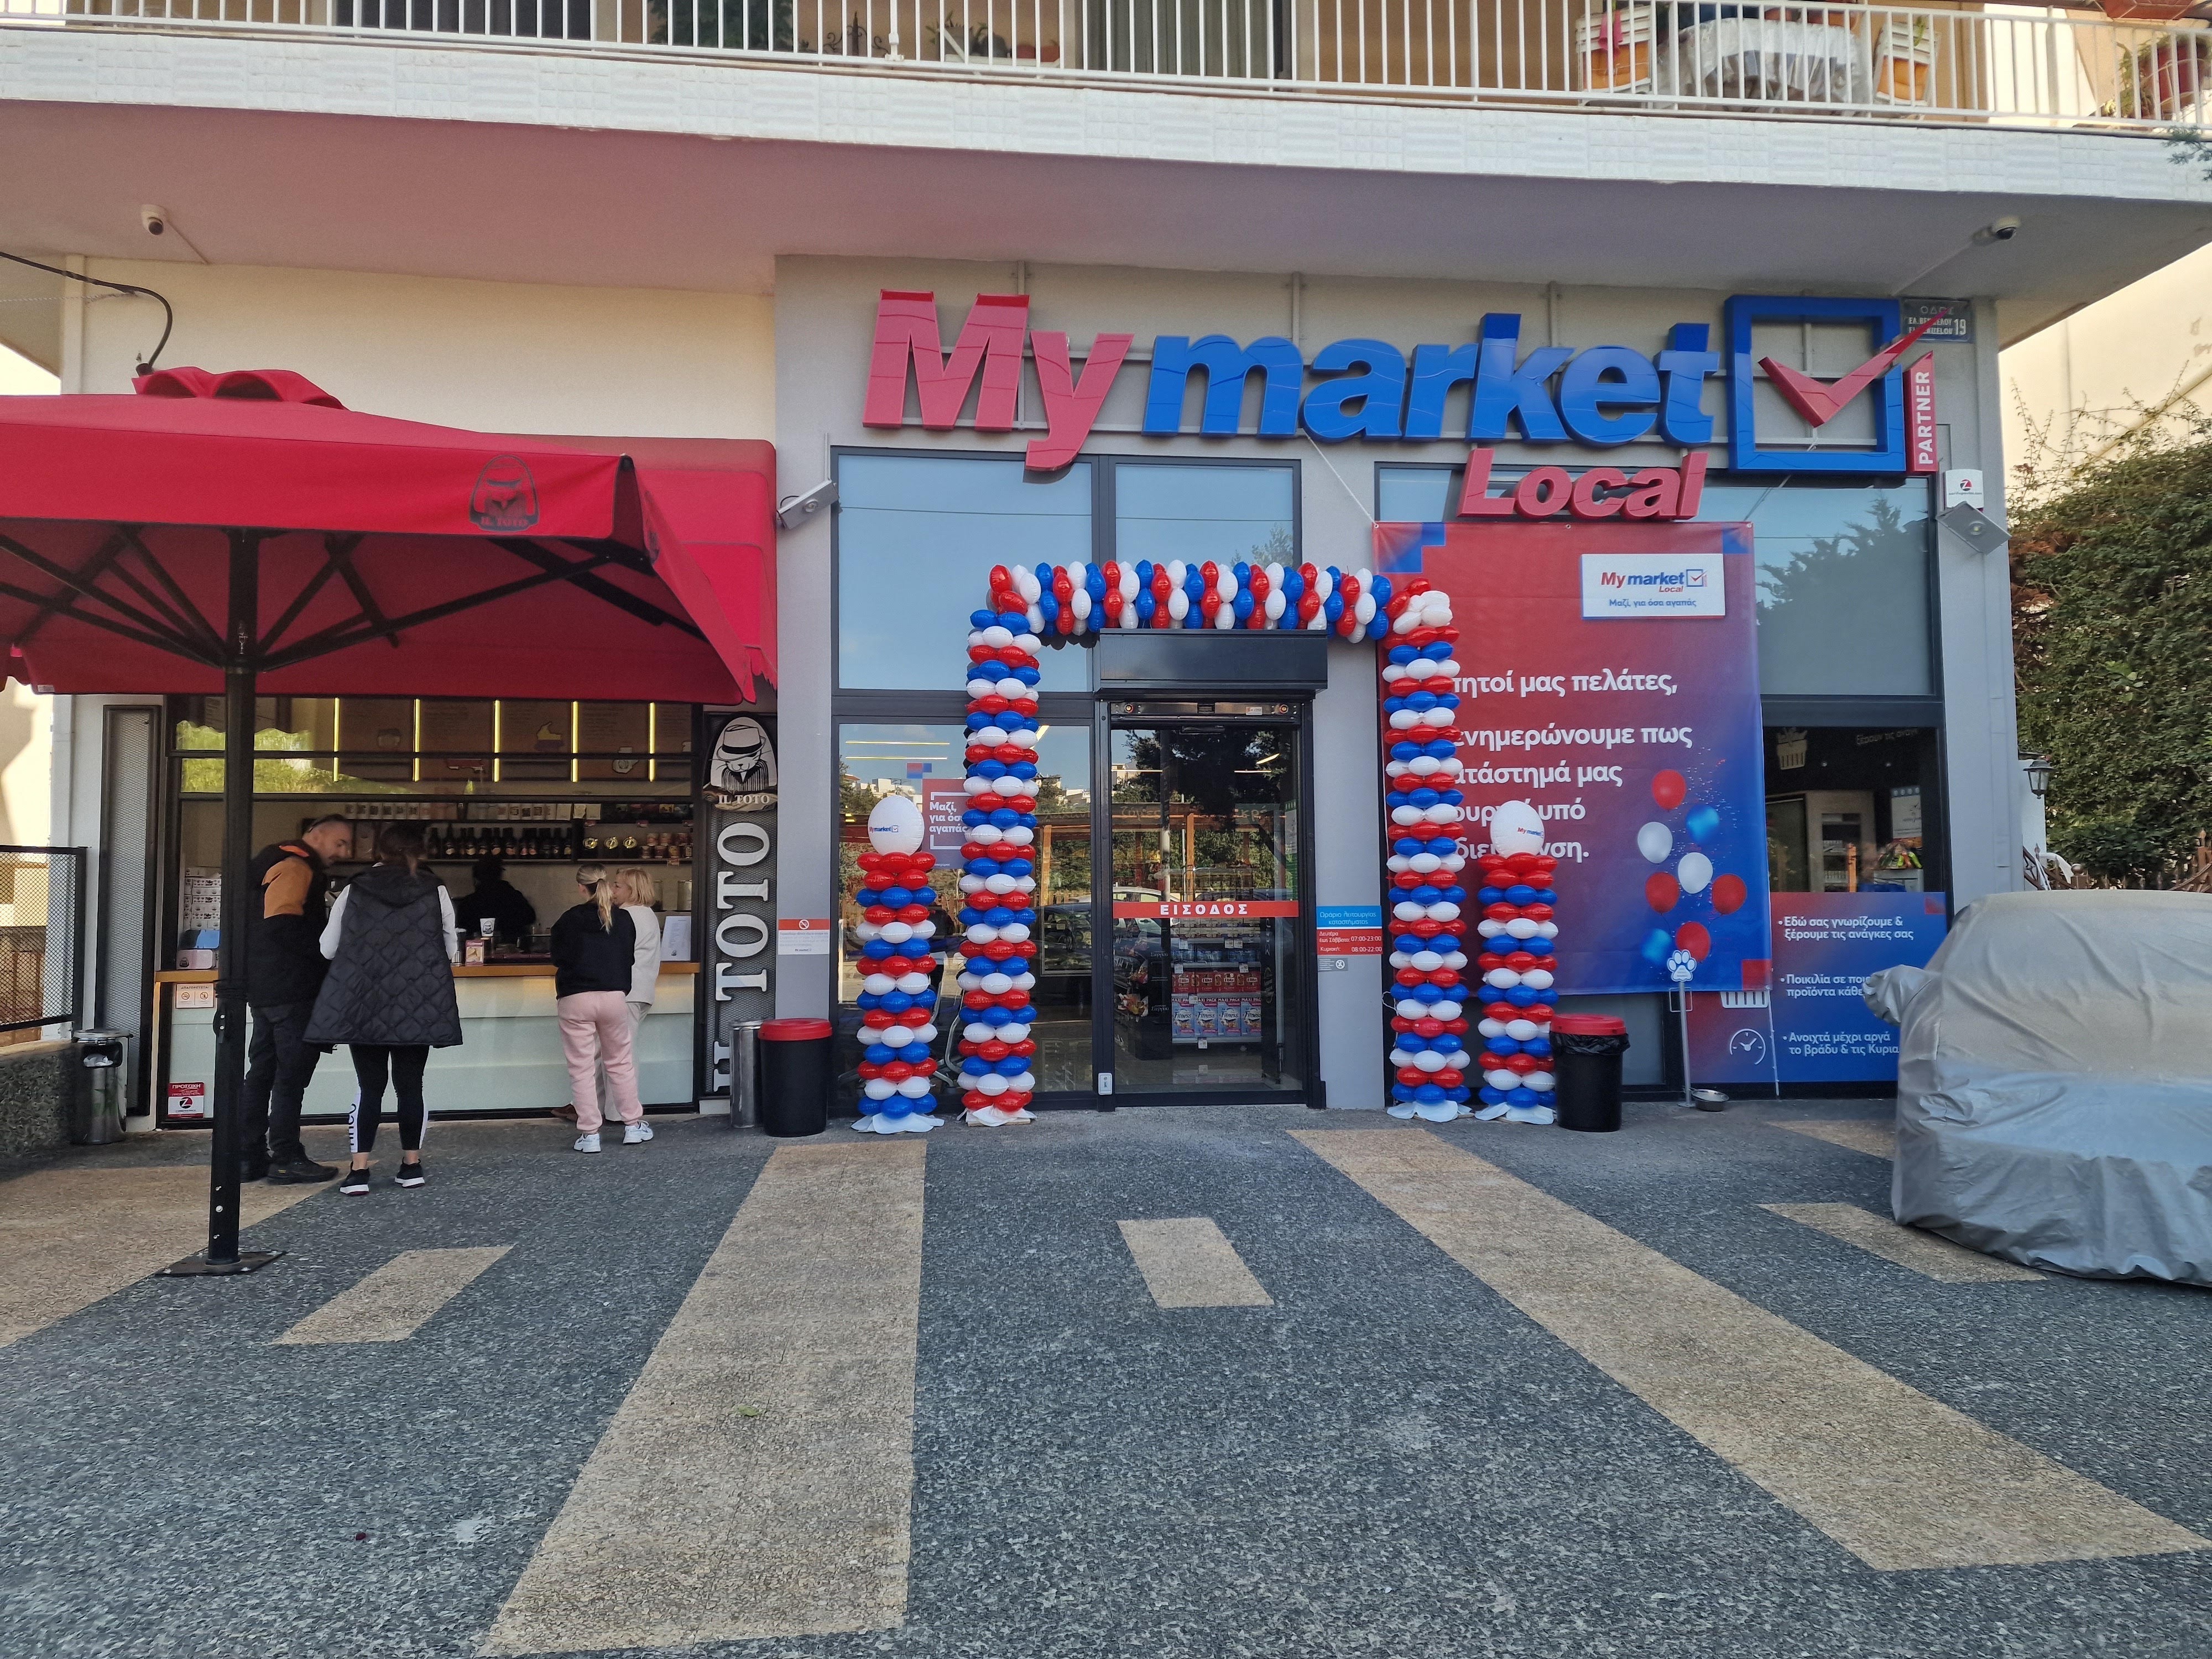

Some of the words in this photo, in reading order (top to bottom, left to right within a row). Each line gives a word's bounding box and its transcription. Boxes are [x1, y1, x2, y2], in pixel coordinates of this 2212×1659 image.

[1954, 319, 1966, 335] 19
[862, 289, 1134, 471] My
[1141, 313, 1719, 446] market
[1916, 372, 1933, 465] PARTNER
[1457, 448, 1708, 519] Local
[1601, 572, 1626, 588] My
[1627, 572, 1684, 585] market
[1666, 598, 1697, 607] αγαπάς
[1521, 675, 1566, 698] μας
[1571, 668, 1678, 696] πελάτες,
[1640, 727, 1693, 749] πως
[1577, 765, 1623, 787] μας
[718, 795, 731, 804] IL
[734, 795, 770, 804] TOTO
[930, 802, 957, 813] Μαζί,
[1538, 797, 1585, 820] υπό
[929, 815, 945, 823] για
[948, 812, 961, 821] όσ
[715, 822, 770, 1001] TOTO
[1160, 904, 1248, 915] ΕΙΣΟΔΟΣ
[1784, 916, 1807, 926] Εδώ
[1809, 919, 1829, 929] σας
[1832, 916, 1892, 929] γνωρίζουμε
[1895, 916, 1903, 926] &
[1785, 928, 1829, 941] ξέρουμε
[1831, 930, 1846, 941] τις
[1848, 929, 1892, 940] ανάγκες
[1894, 930, 1914, 940] σας
[1786, 973, 1830, 984] Ποικιλία
[1786, 986, 1836, 999] προϊόντα
[1838, 986, 1863, 996] κάθε
[1789, 1031, 1830, 1044] Ανοιχτά
[1833, 1032, 1861, 1044] μέχρι
[1864, 1031, 1891, 1042] αργά
[1804, 1045, 1838, 1056] βράδυ
[1840, 1045, 1849, 1054] &
[1851, 1046, 1866, 1056] τις
